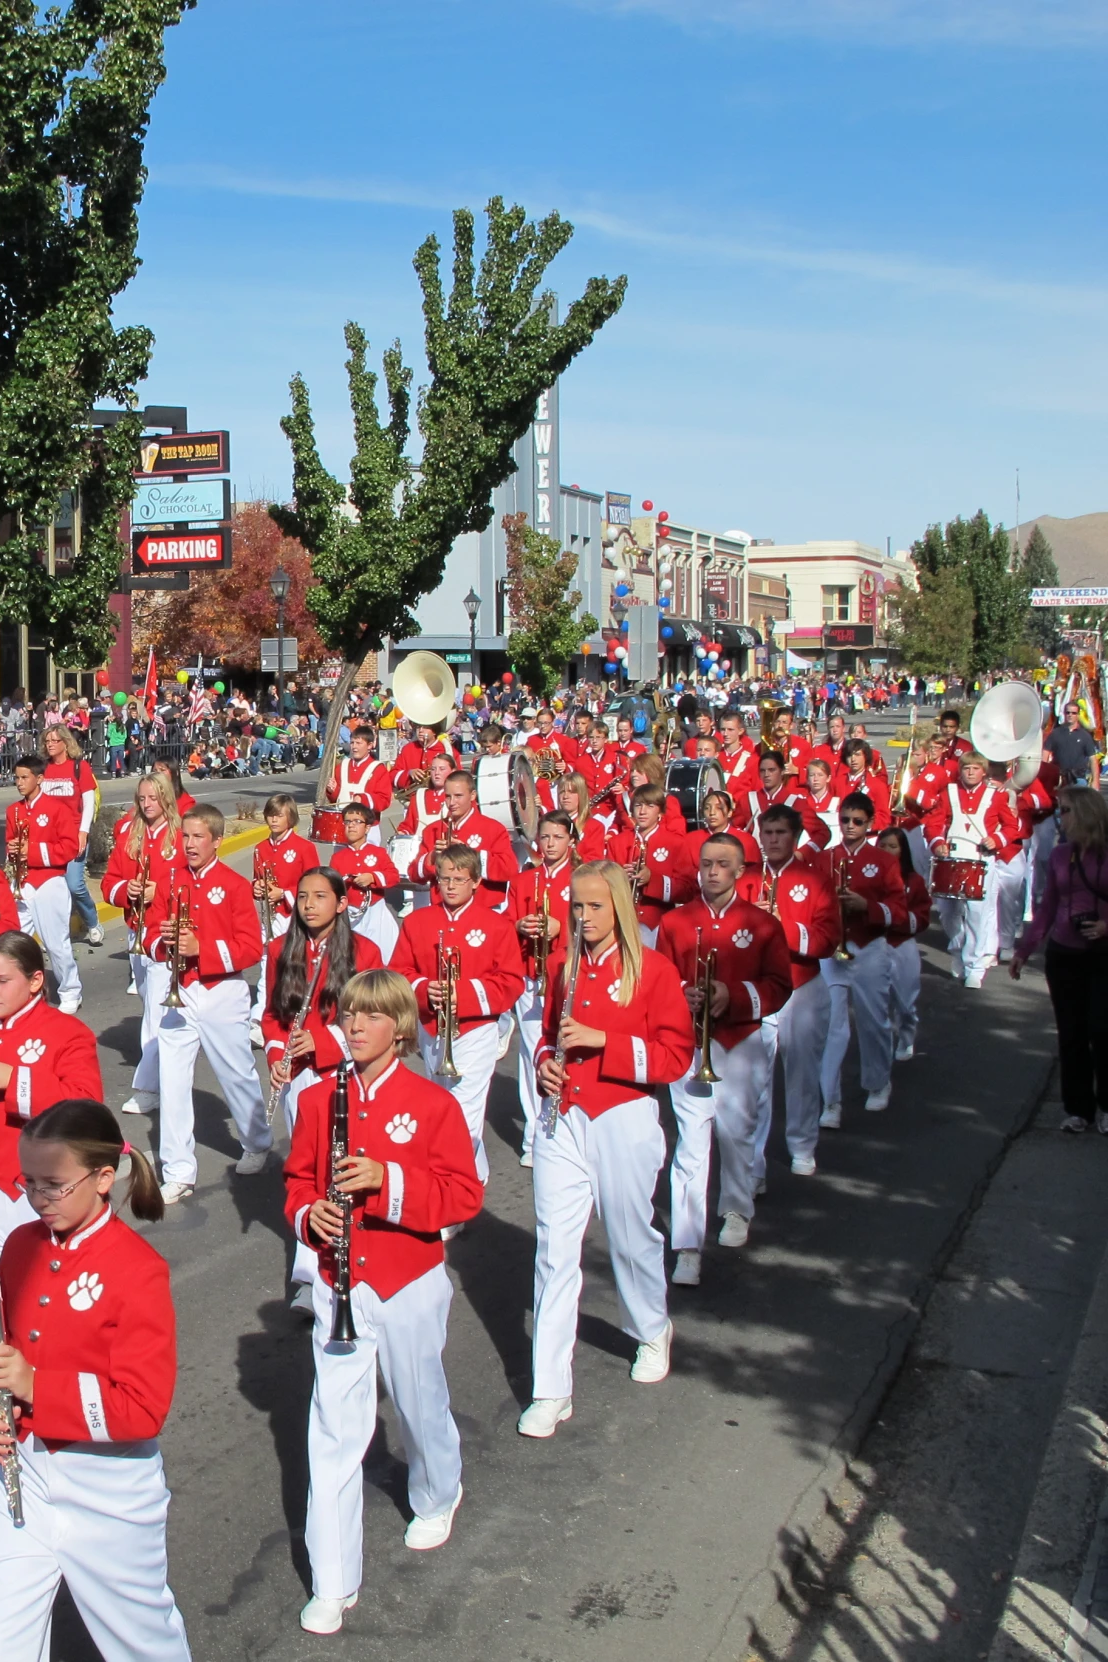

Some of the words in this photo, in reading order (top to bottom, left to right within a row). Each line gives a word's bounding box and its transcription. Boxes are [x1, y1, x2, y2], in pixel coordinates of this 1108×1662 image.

[161, 446, 177, 460] THE
[178, 445, 194, 459] TAP
[195, 443, 218, 457] ROOM
[140, 487, 198, 520] Salon
[159, 503, 213, 514] CHOCOLAT
[147, 539, 217, 561] PARKING
[1032, 589, 1047, 597] AY
[1052, 588, 1107, 597] WEEKEND
[1032, 598, 1061, 606] ARADE
[391, 1197, 400, 1217] PJHS
[88, 1402, 102, 1429] PJHS
